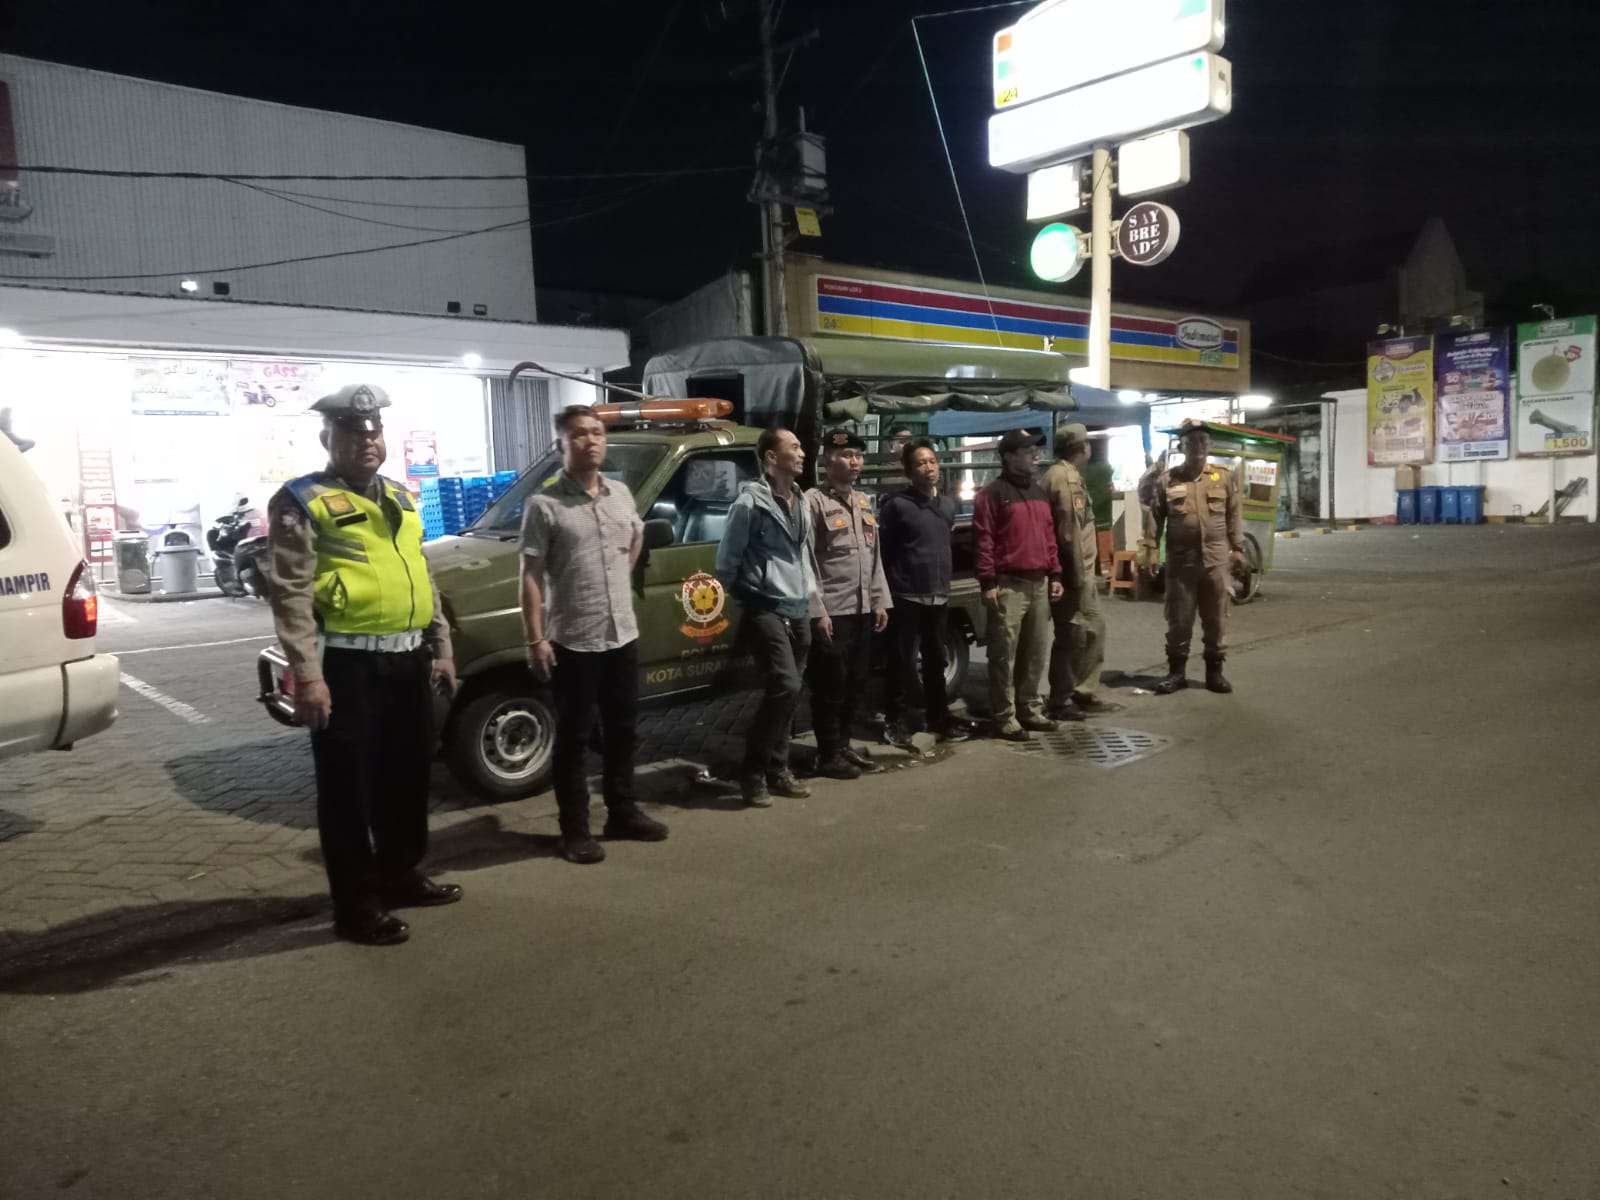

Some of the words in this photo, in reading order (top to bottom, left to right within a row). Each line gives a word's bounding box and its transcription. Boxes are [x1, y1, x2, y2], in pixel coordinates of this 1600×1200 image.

[1128, 208, 1160, 229] SAY
[1129, 223, 1161, 243] BRE
[263, 365, 299, 378] GASS
[646, 668, 682, 685] KOTA
